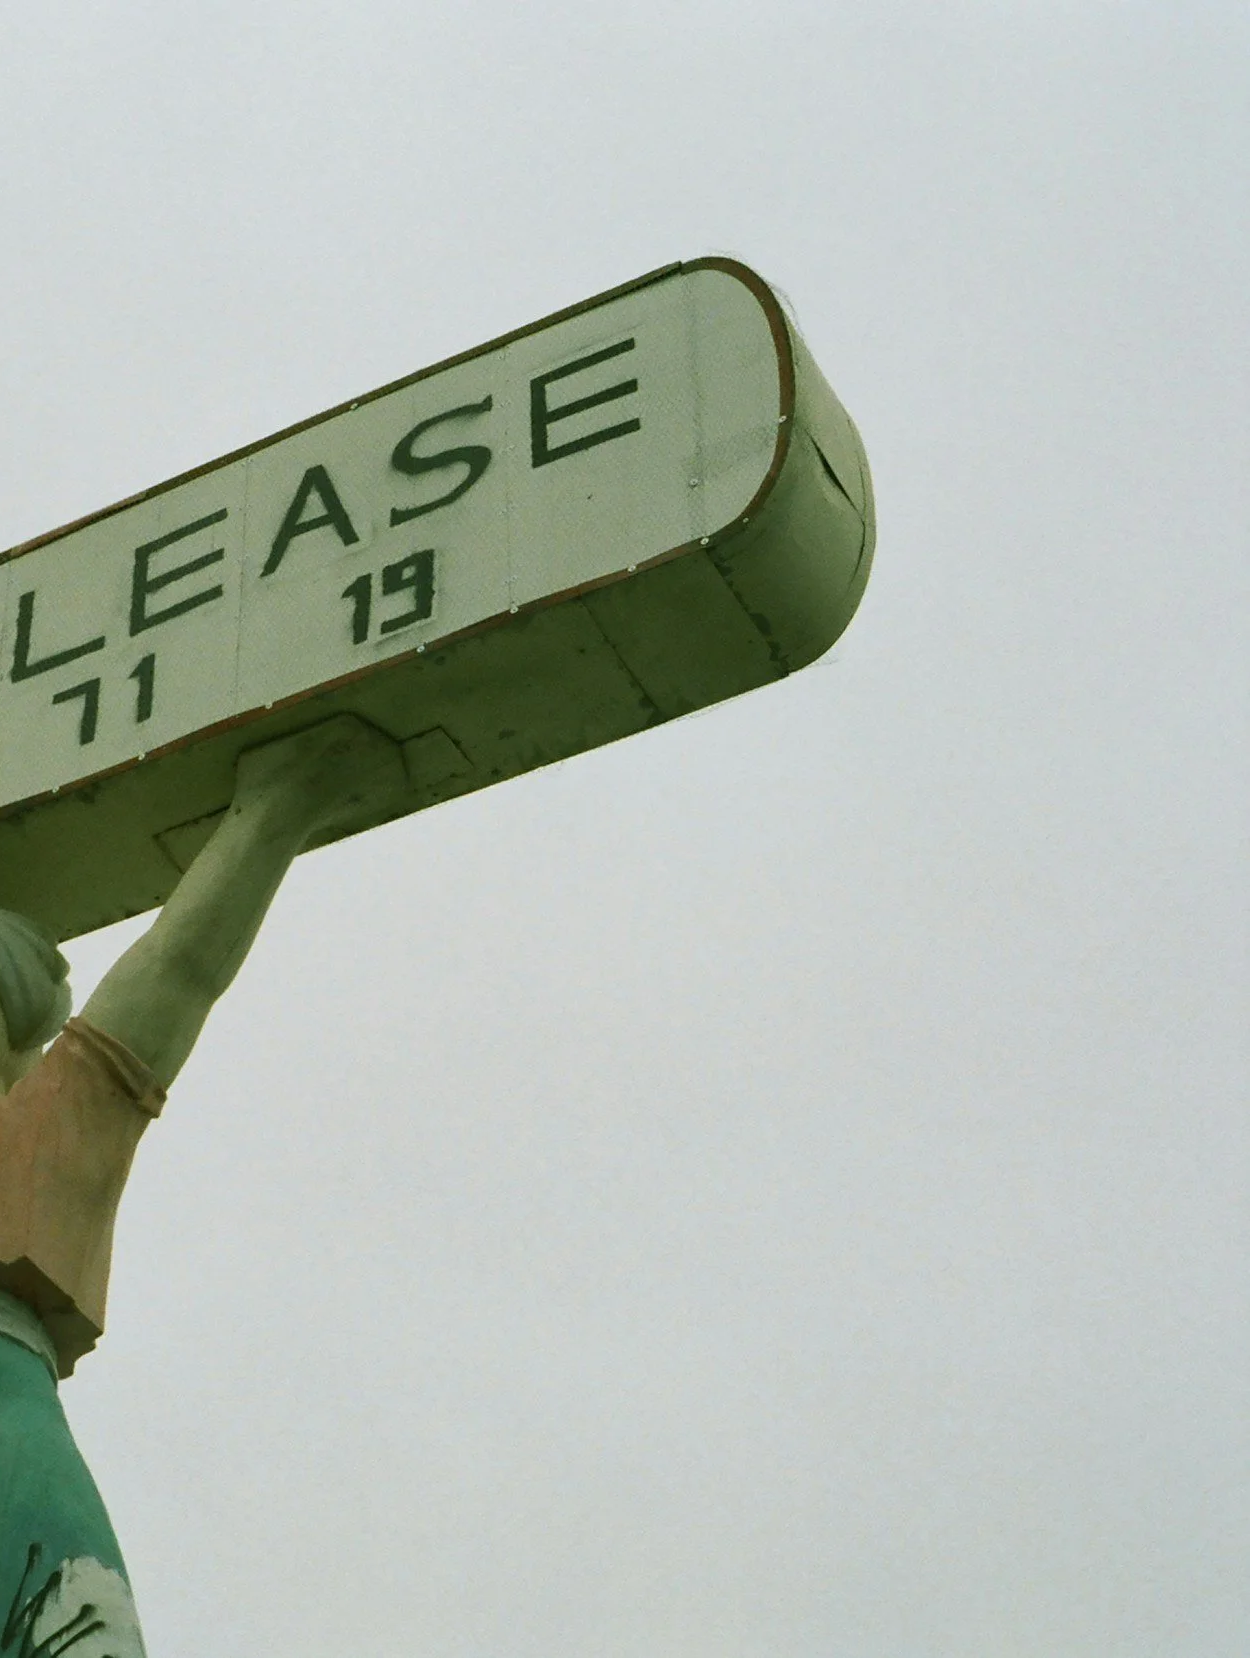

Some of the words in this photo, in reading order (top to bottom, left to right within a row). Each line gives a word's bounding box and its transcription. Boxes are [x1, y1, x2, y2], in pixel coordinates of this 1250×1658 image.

[10, 337, 641, 684] LEASE
[52, 652, 156, 746] 71
[340, 548, 436, 645] 19
